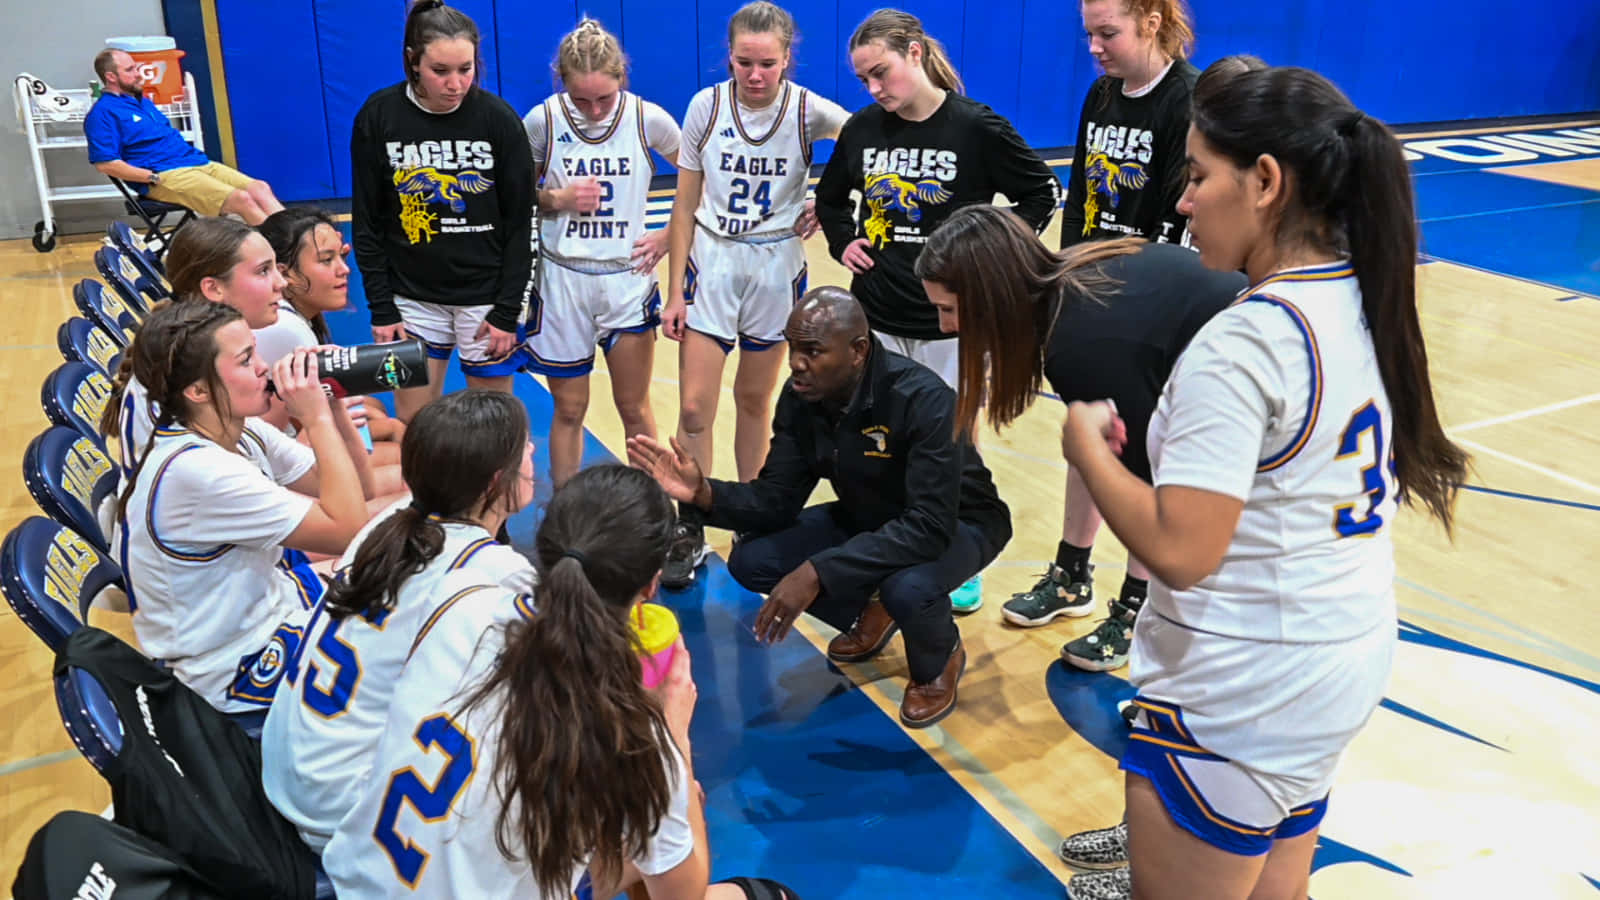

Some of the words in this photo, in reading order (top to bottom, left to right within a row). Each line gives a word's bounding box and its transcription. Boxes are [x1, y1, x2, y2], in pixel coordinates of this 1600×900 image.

[386, 140, 495, 170] EAGLES
[1086, 122, 1154, 164] EAGLES
[562, 157, 631, 177] EAGLE
[719, 152, 788, 177] EAGLE
[863, 147, 958, 182] EAGLES
[728, 177, 772, 217] 24
[565, 220, 629, 239] POINT
[1332, 397, 1400, 539] 3
